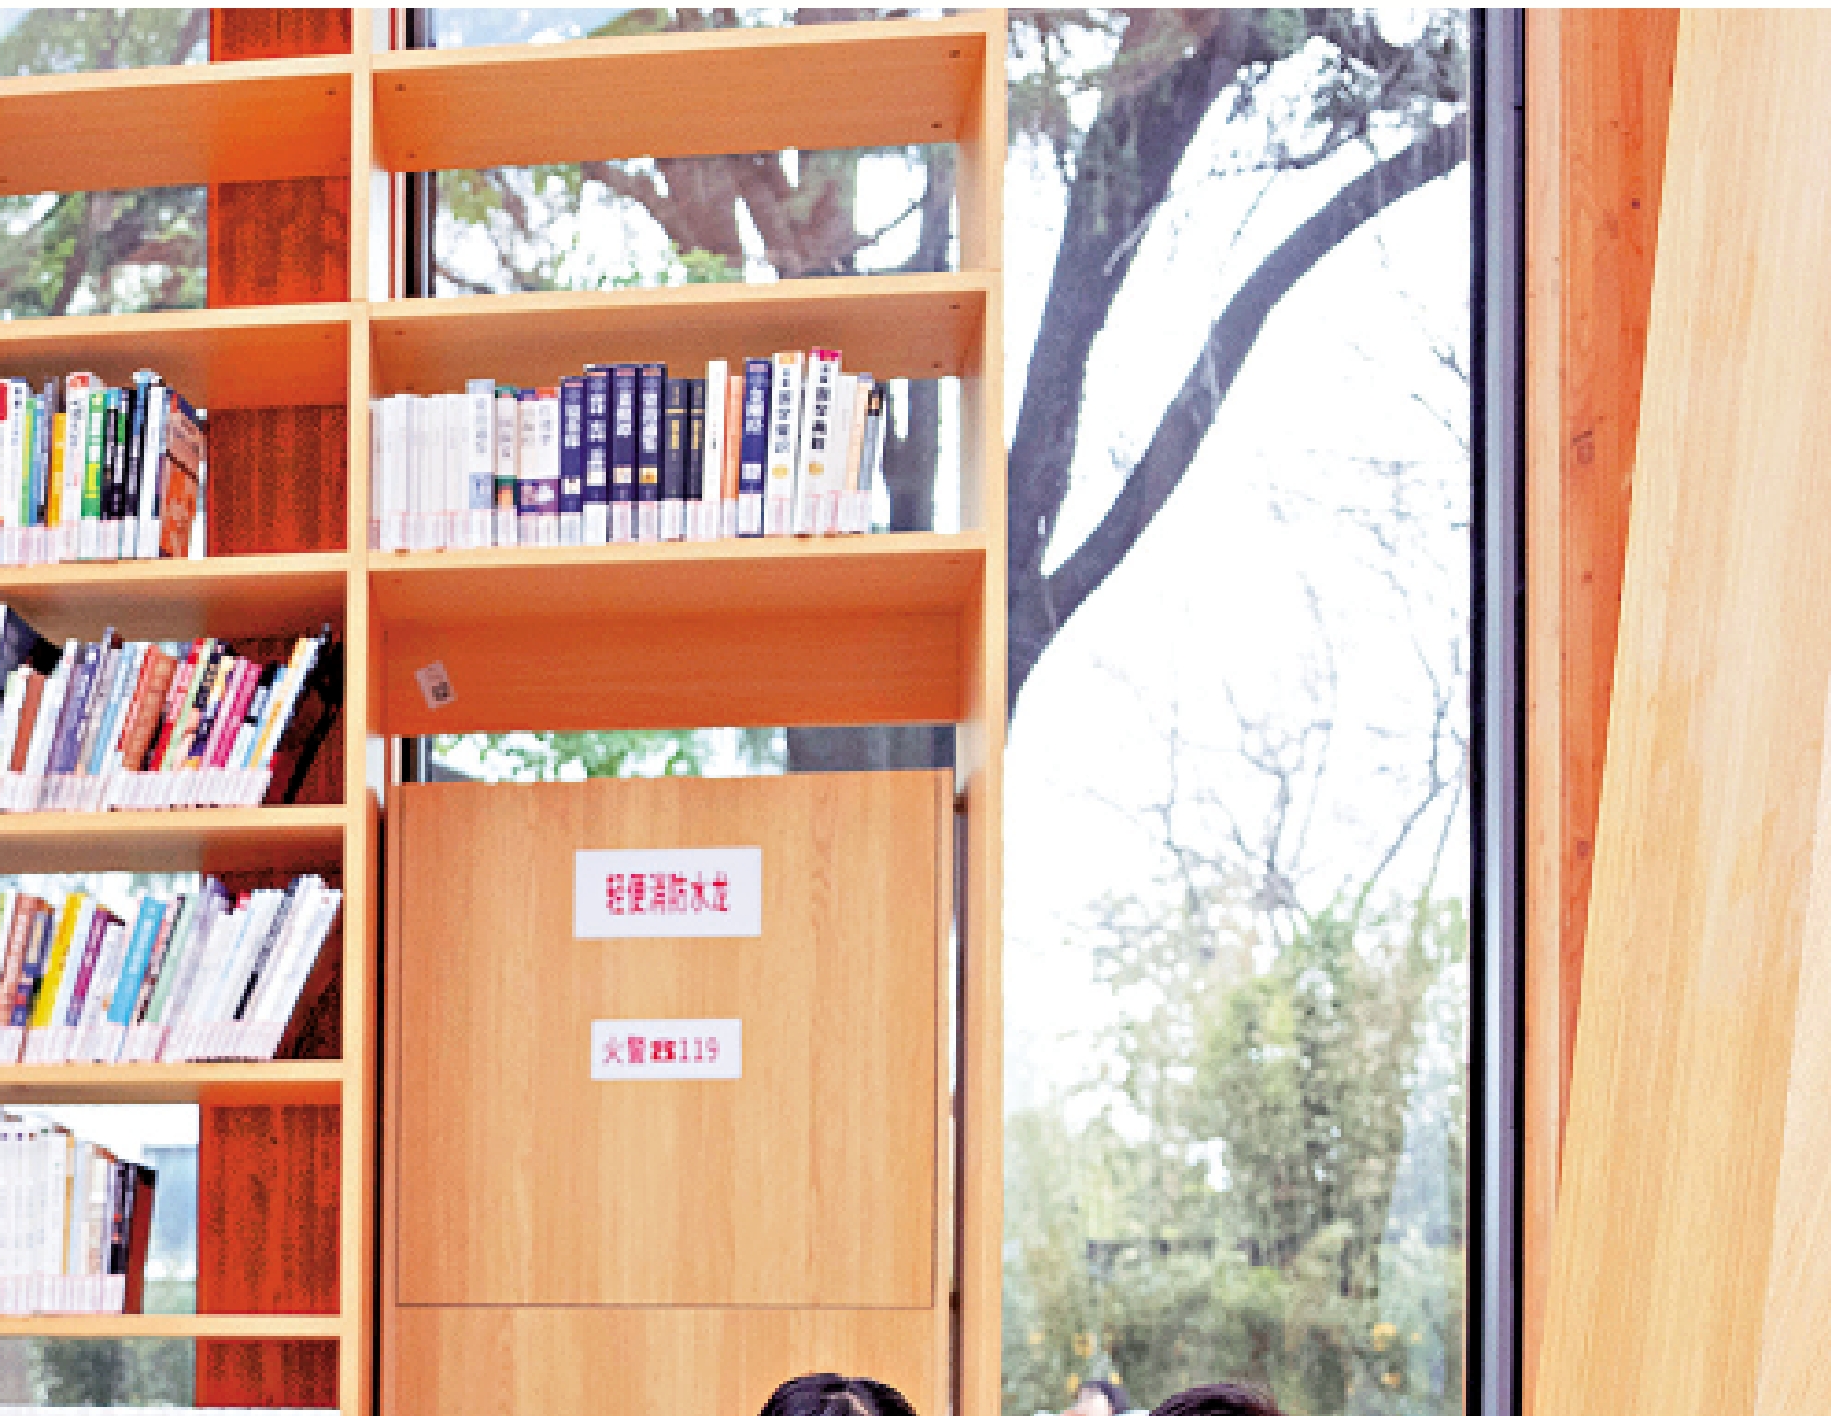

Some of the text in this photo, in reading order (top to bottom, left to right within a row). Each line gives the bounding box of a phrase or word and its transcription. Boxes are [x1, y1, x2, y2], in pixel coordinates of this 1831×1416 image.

[605, 870, 730, 916] 轻便消防水龙
